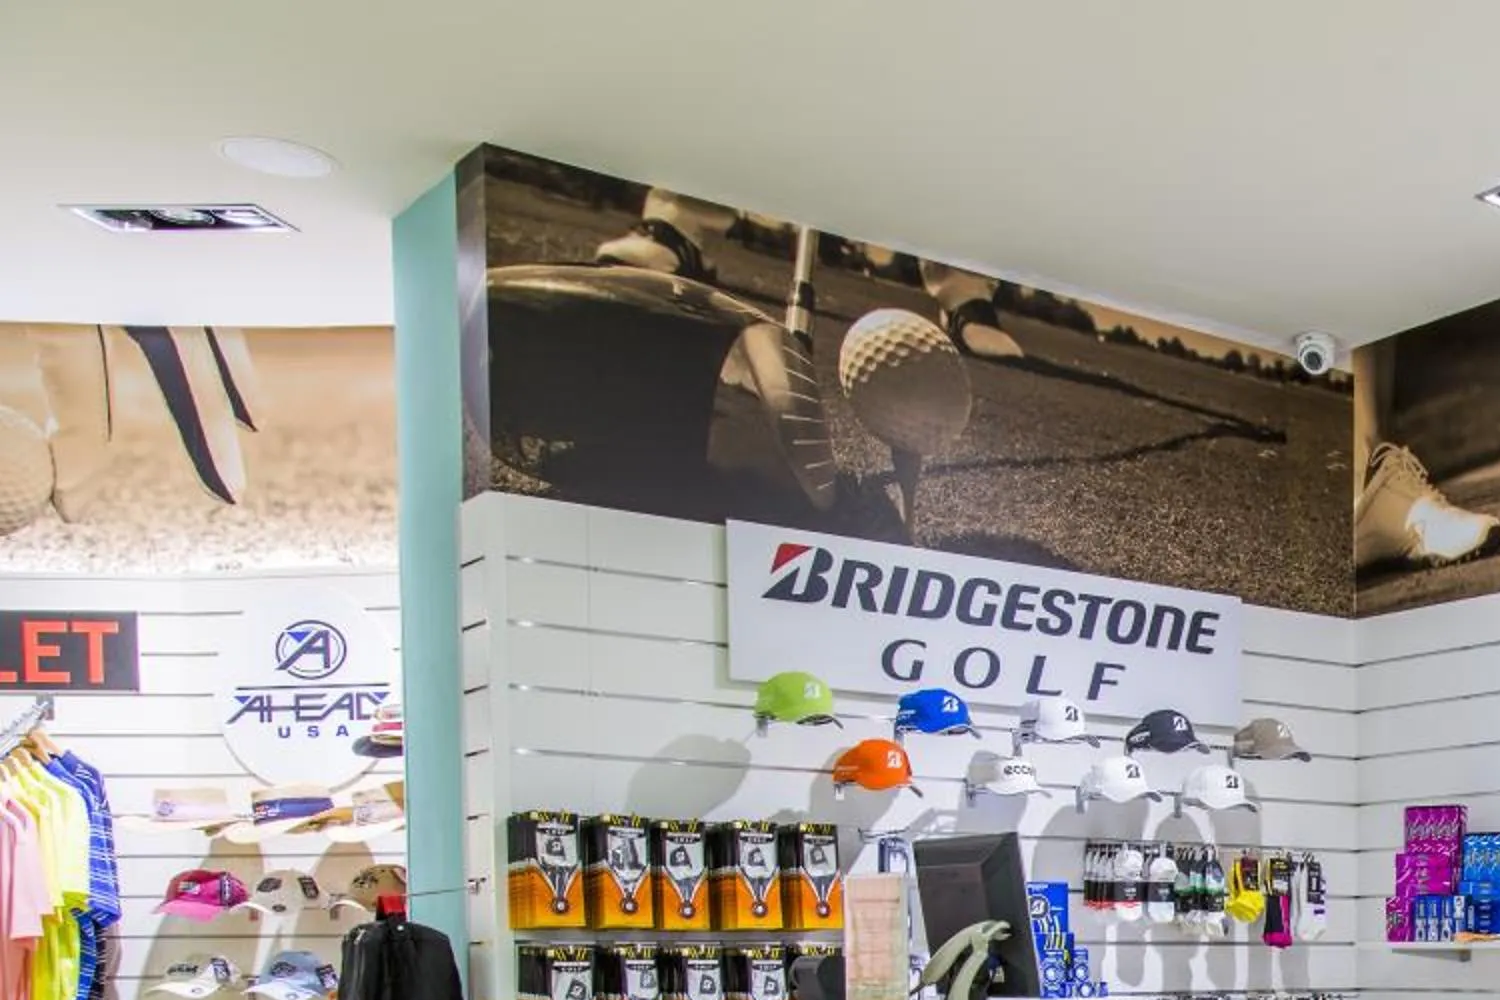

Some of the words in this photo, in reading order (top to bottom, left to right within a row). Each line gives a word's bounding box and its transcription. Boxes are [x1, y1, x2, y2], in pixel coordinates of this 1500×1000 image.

[762, 542, 1221, 655] BRIDGESTONE
[881, 638, 1127, 701] GOLF
[278, 725, 349, 738] USA
